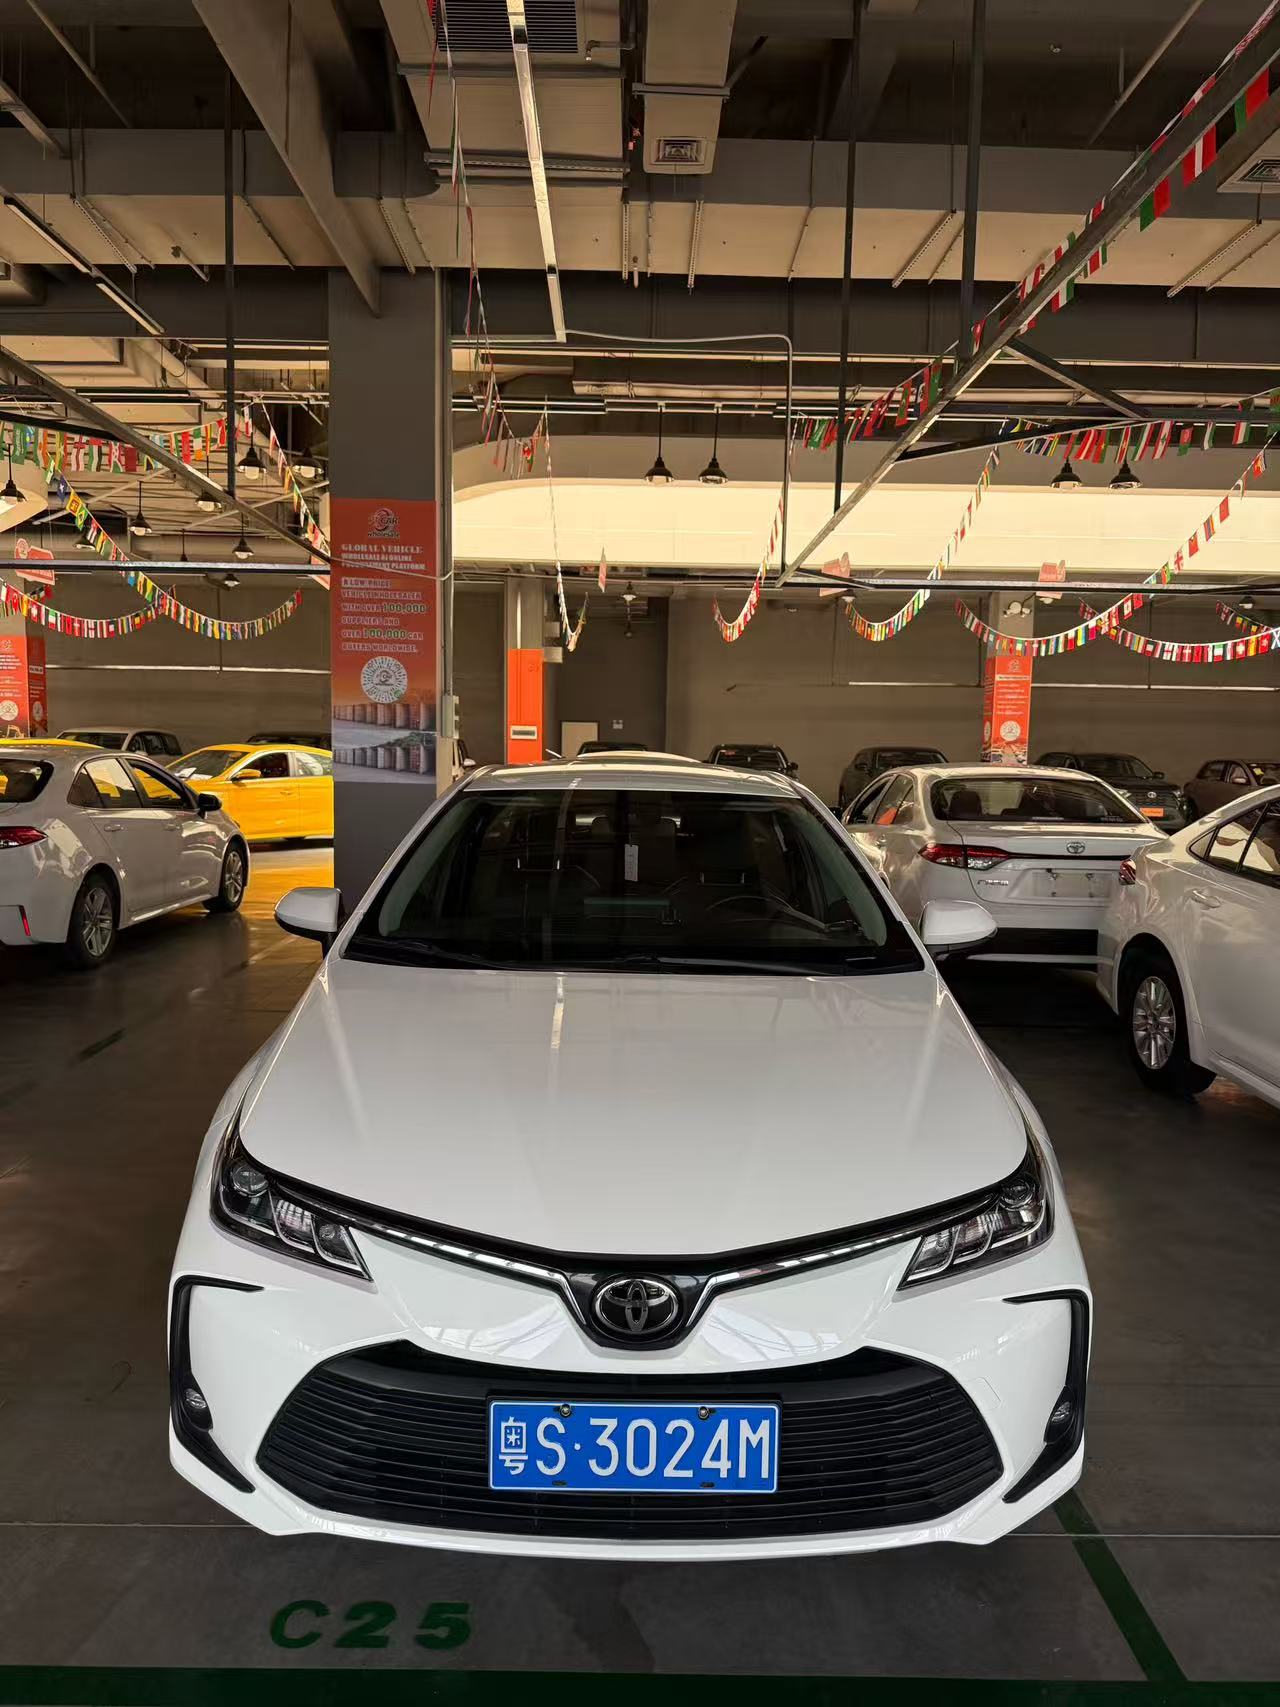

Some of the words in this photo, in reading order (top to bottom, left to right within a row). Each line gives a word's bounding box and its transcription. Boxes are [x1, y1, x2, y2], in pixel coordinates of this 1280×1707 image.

[341, 543, 380, 552] GLOBAL
[381, 545, 424, 554] VEHICLE
[341, 552, 380, 561] WHOLESALE
[389, 554, 412, 562] ONLINE
[383, 602, 426, 614] 100,000
[383, 617, 400, 626] AND
[342, 629, 363, 638] OVER
[364, 627, 407, 640] 100,000
[407, 631, 424, 641] CAR
[270, 1599, 472, 1649] C25
